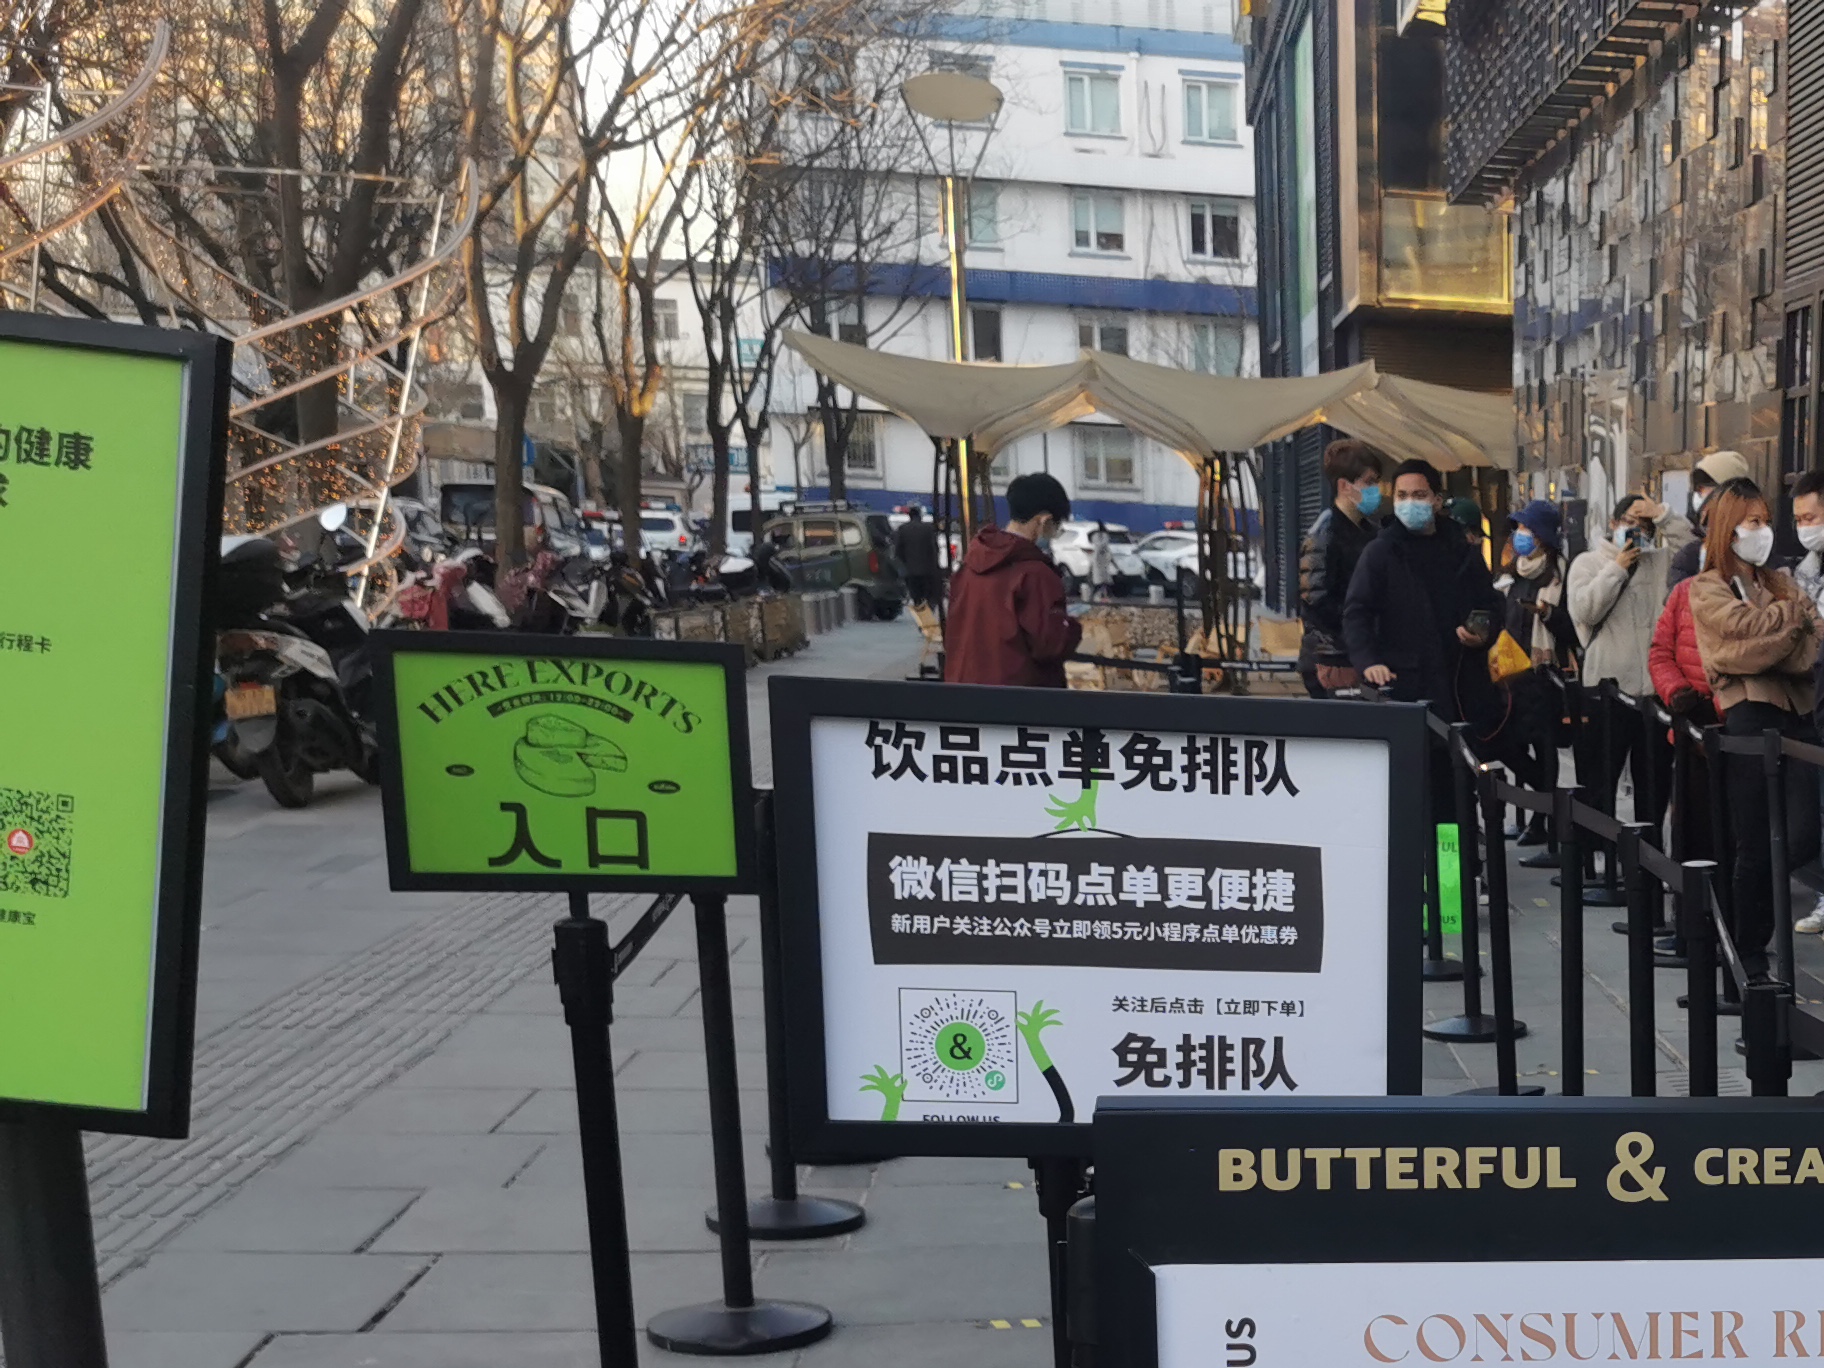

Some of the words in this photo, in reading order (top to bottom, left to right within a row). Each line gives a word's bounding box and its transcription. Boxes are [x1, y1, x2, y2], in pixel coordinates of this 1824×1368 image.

[417, 662, 520, 725] HERE
[523, 657, 702, 734] EXPORTS
[864, 721, 1300, 797] 饮品点单免排队
[488, 802, 649, 870] 入口
[889, 856, 1295, 912] 微信扫码点单更便捷
[892, 914, 1298, 945] 新用户关注公众号立即领5元小程序点单优惠券
[1112, 996, 1303, 1017] 关注后点击【立即下单】
[1112, 1032, 1299, 1093] 免排队
[1219, 1147, 1576, 1191] BUTTERFUL
[1607, 1132, 1668, 1202] &
[1364, 1311, 1749, 1363] CONSUMER
